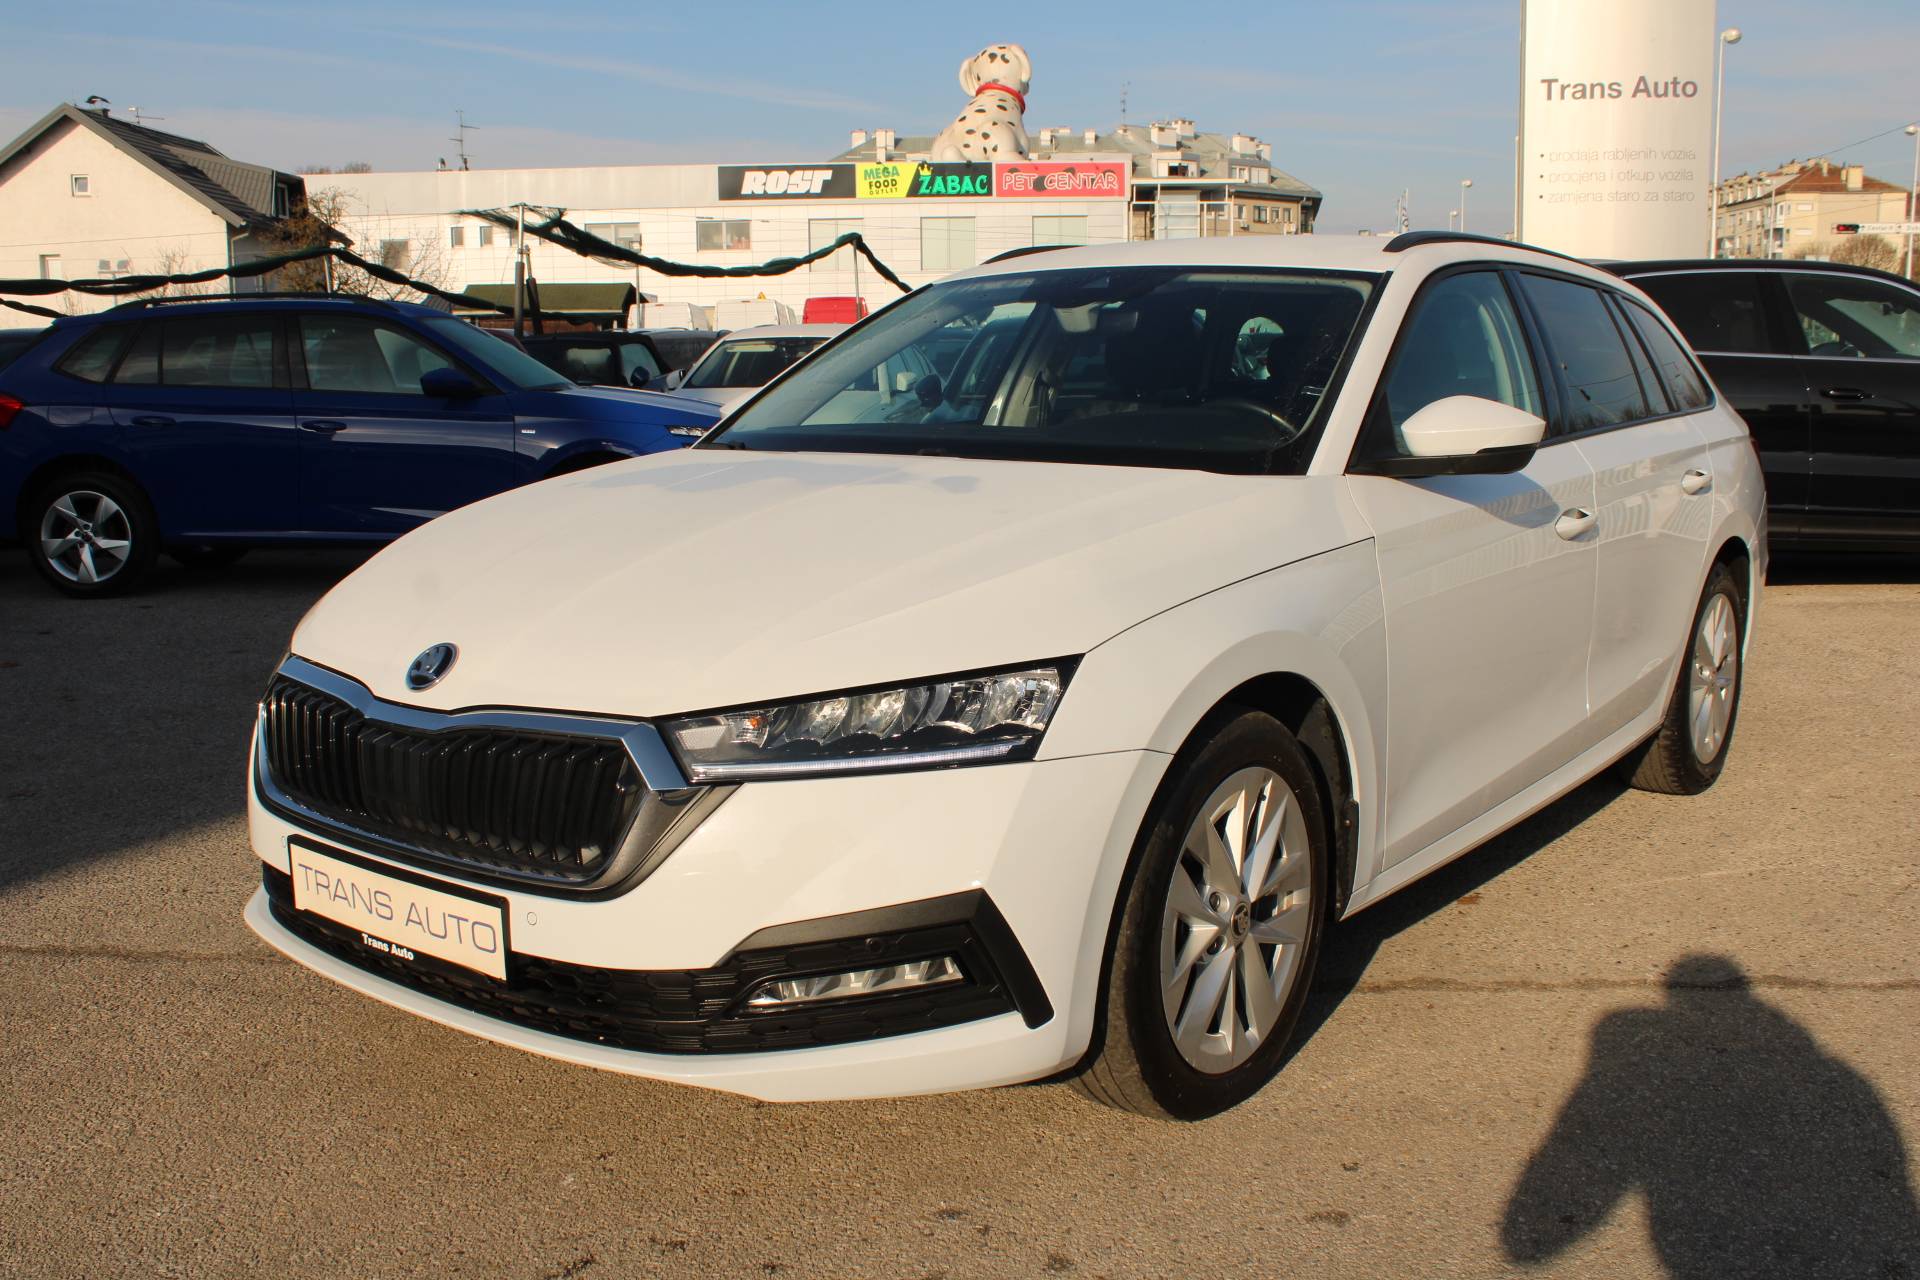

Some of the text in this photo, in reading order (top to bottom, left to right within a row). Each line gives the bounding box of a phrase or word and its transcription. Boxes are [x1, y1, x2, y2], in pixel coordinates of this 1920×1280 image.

[1541, 75, 1698, 101] Trans Auto
[1549, 147, 1696, 163] prodaja rabljenih vozila
[864, 166, 900, 180] MEGA
[1003, 172, 1119, 191] PET CENTAR
[1617, 168, 1655, 183] otkup
[1658, 168, 1694, 181] vozila
[741, 169, 833, 195] ROST
[868, 179, 898, 190] FOOD
[1607, 190, 1640, 201] staro
[1643, 191, 1659, 201] za
[1662, 190, 1695, 201] staro
[298, 863, 497, 953] TRANS AUTO
[362, 932, 414, 961] Trans Auto
